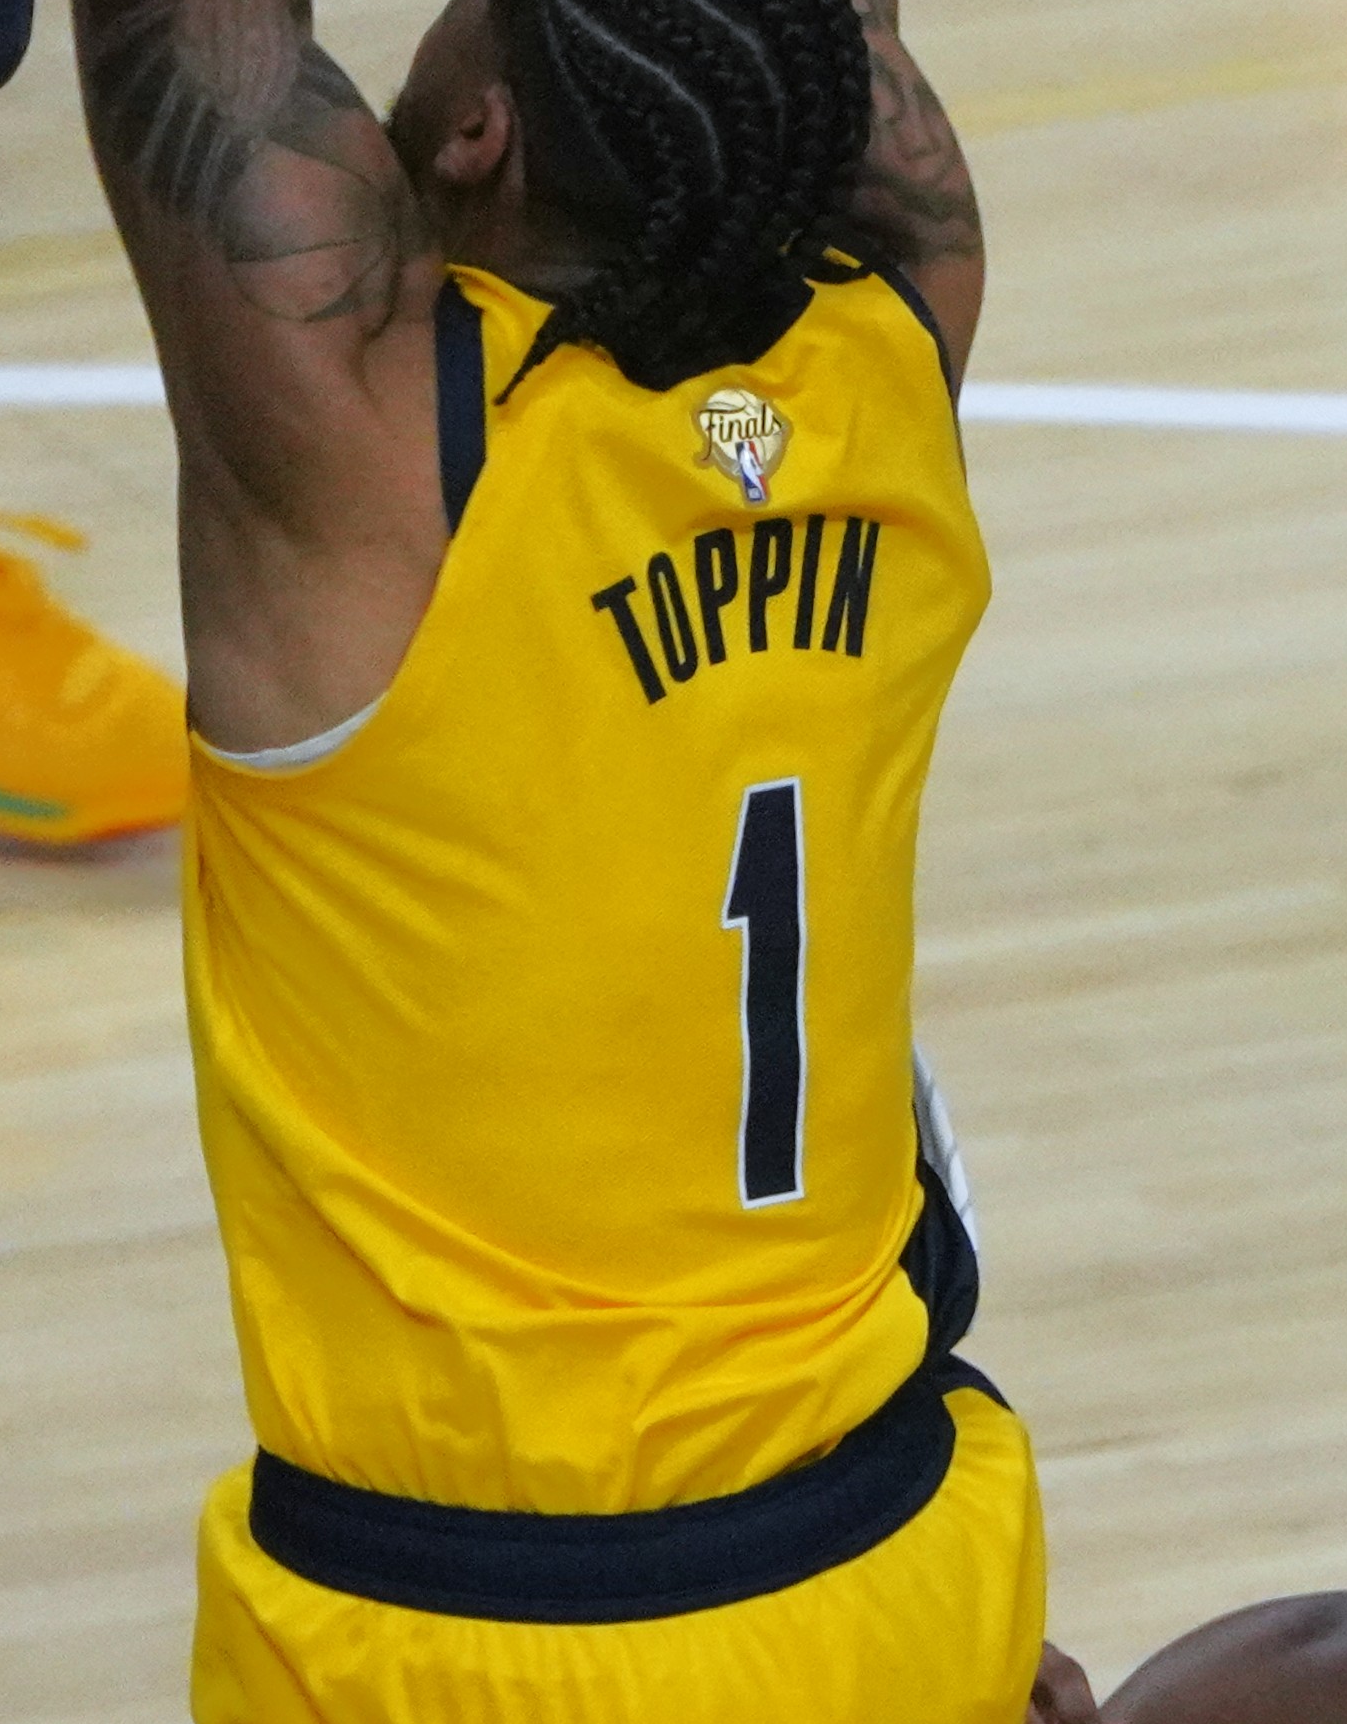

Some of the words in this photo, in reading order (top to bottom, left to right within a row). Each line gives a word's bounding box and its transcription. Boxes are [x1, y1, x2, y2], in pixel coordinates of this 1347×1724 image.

[698, 402, 782, 462] Finals
[591, 514, 881, 705] TOPPIN
[722, 776, 807, 1210] 1
